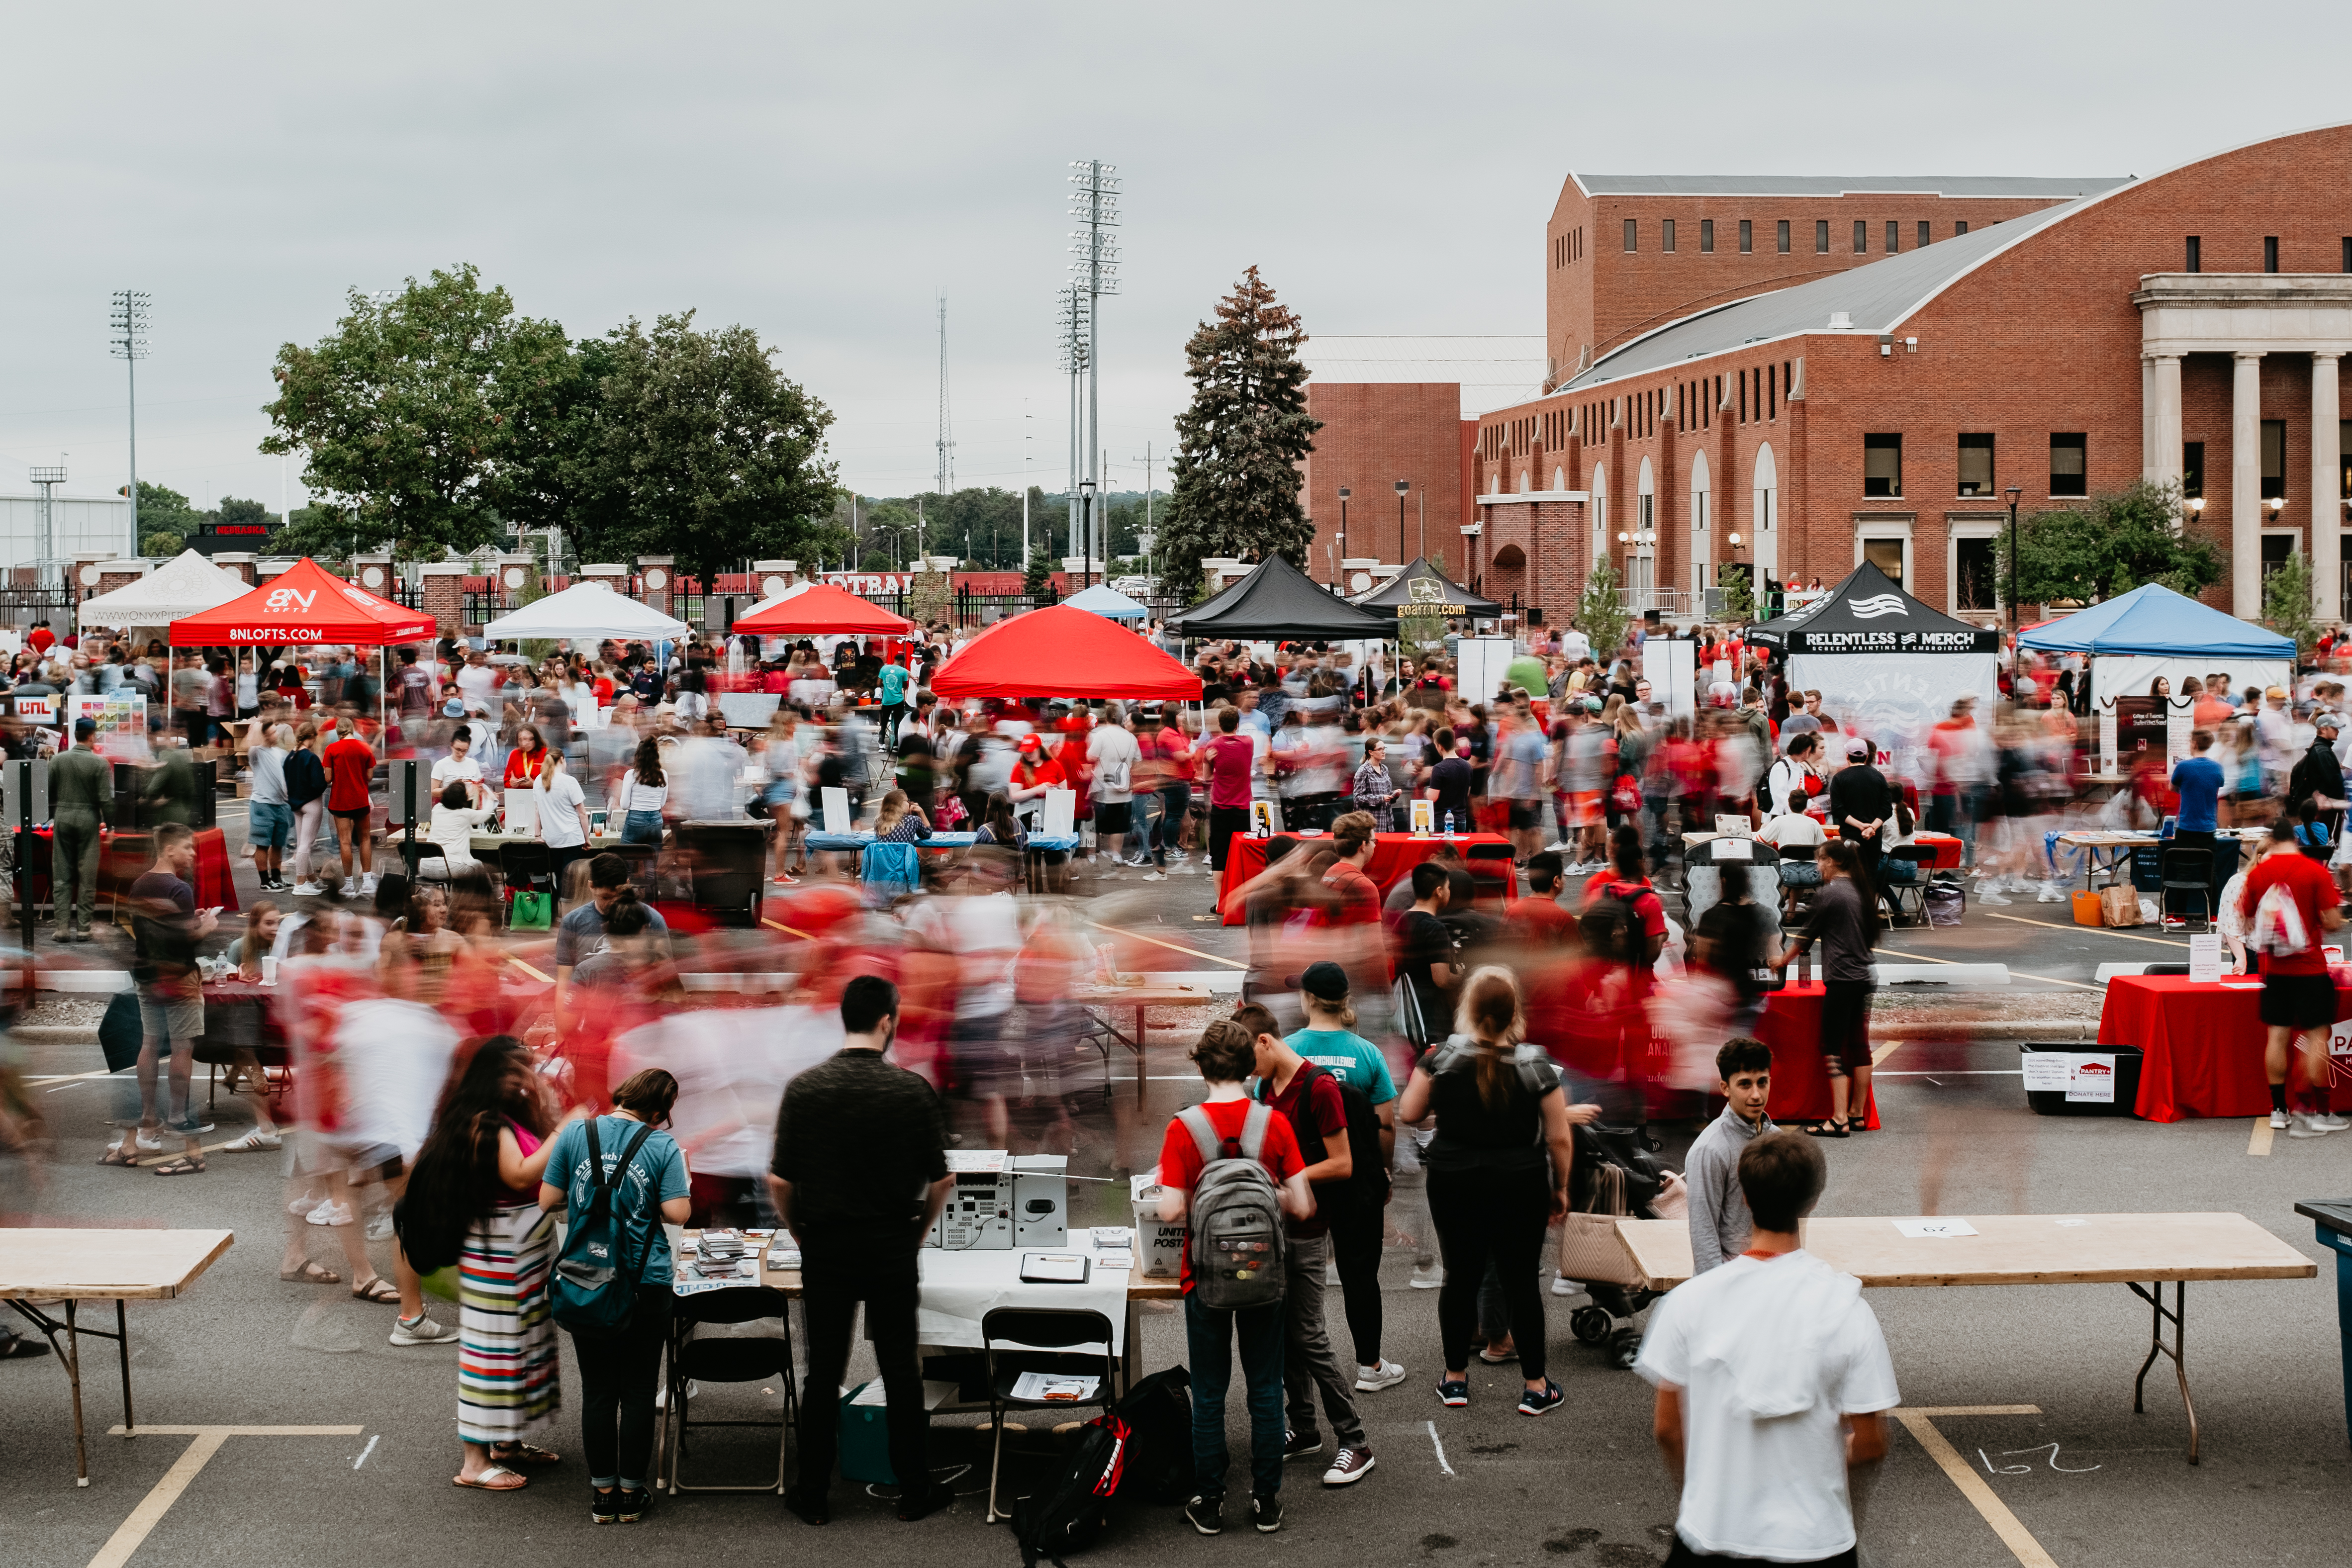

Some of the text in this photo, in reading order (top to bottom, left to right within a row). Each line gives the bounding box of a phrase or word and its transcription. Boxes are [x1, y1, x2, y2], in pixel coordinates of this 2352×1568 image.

[266, 589, 317, 607] 8N
[230, 629, 322, 640] 8NLOFTS.COM
[1806, 633, 1974, 645] RELENTLESS MERCH
[20, 702, 51, 715] UNL
[1877, 751, 1891, 765] N
[1158, 1227, 1187, 1237] UNITE
